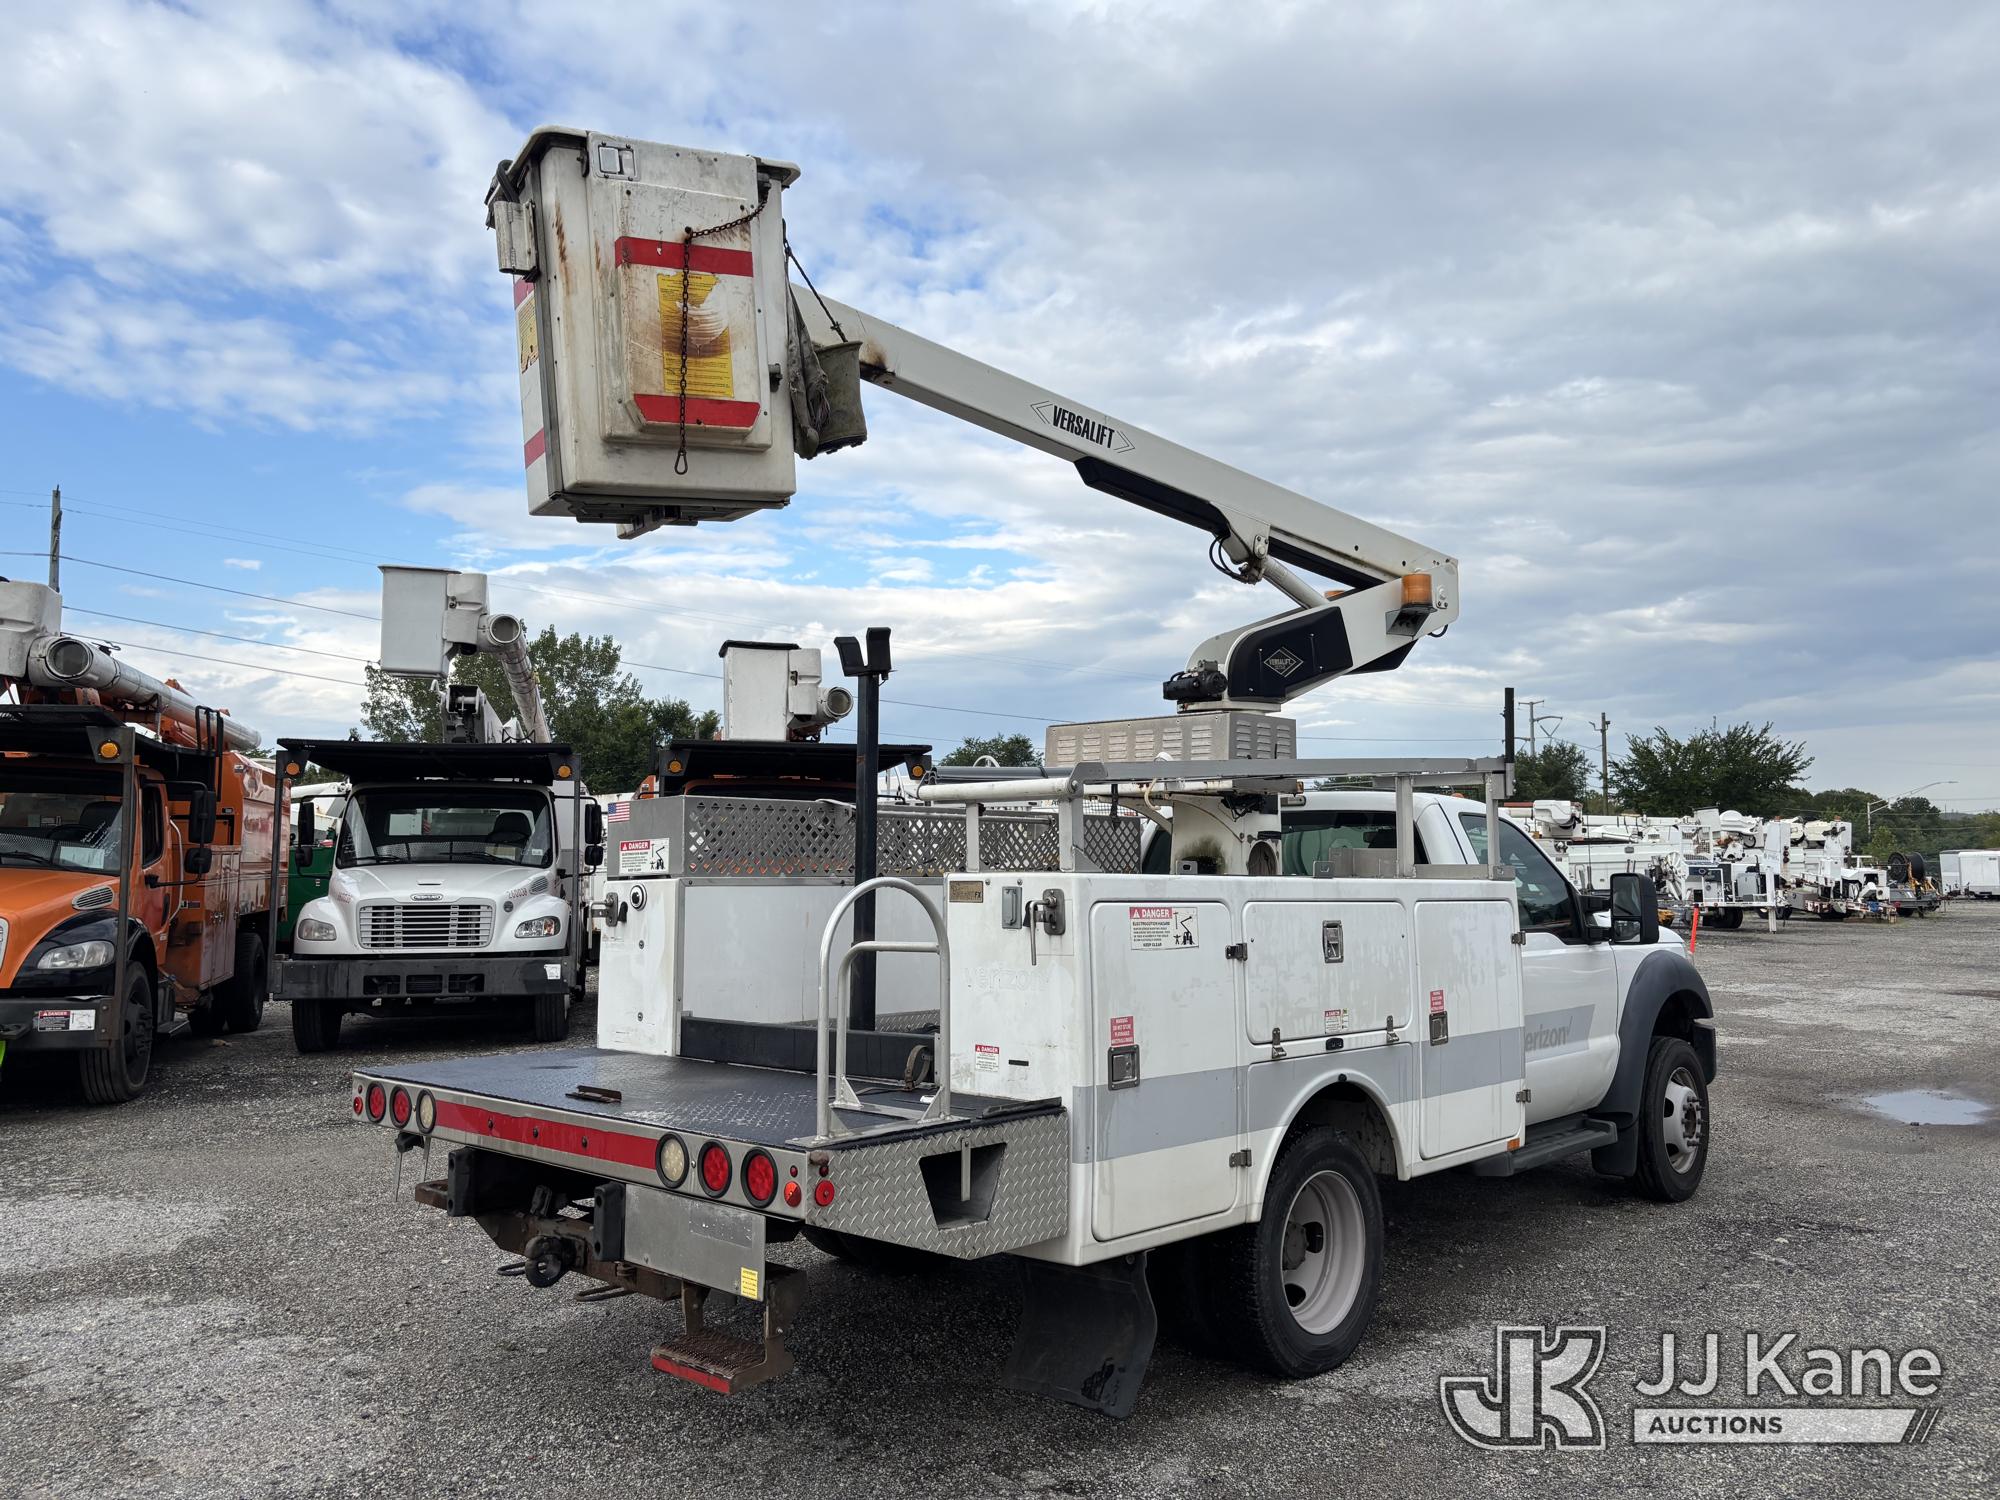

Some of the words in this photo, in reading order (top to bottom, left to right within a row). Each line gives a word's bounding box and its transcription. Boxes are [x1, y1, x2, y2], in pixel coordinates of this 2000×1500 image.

[1053, 405, 1115, 449] VERSALIFT
[1141, 909, 1170, 918] DANGER
[1525, 1024, 1569, 1052] erizon
